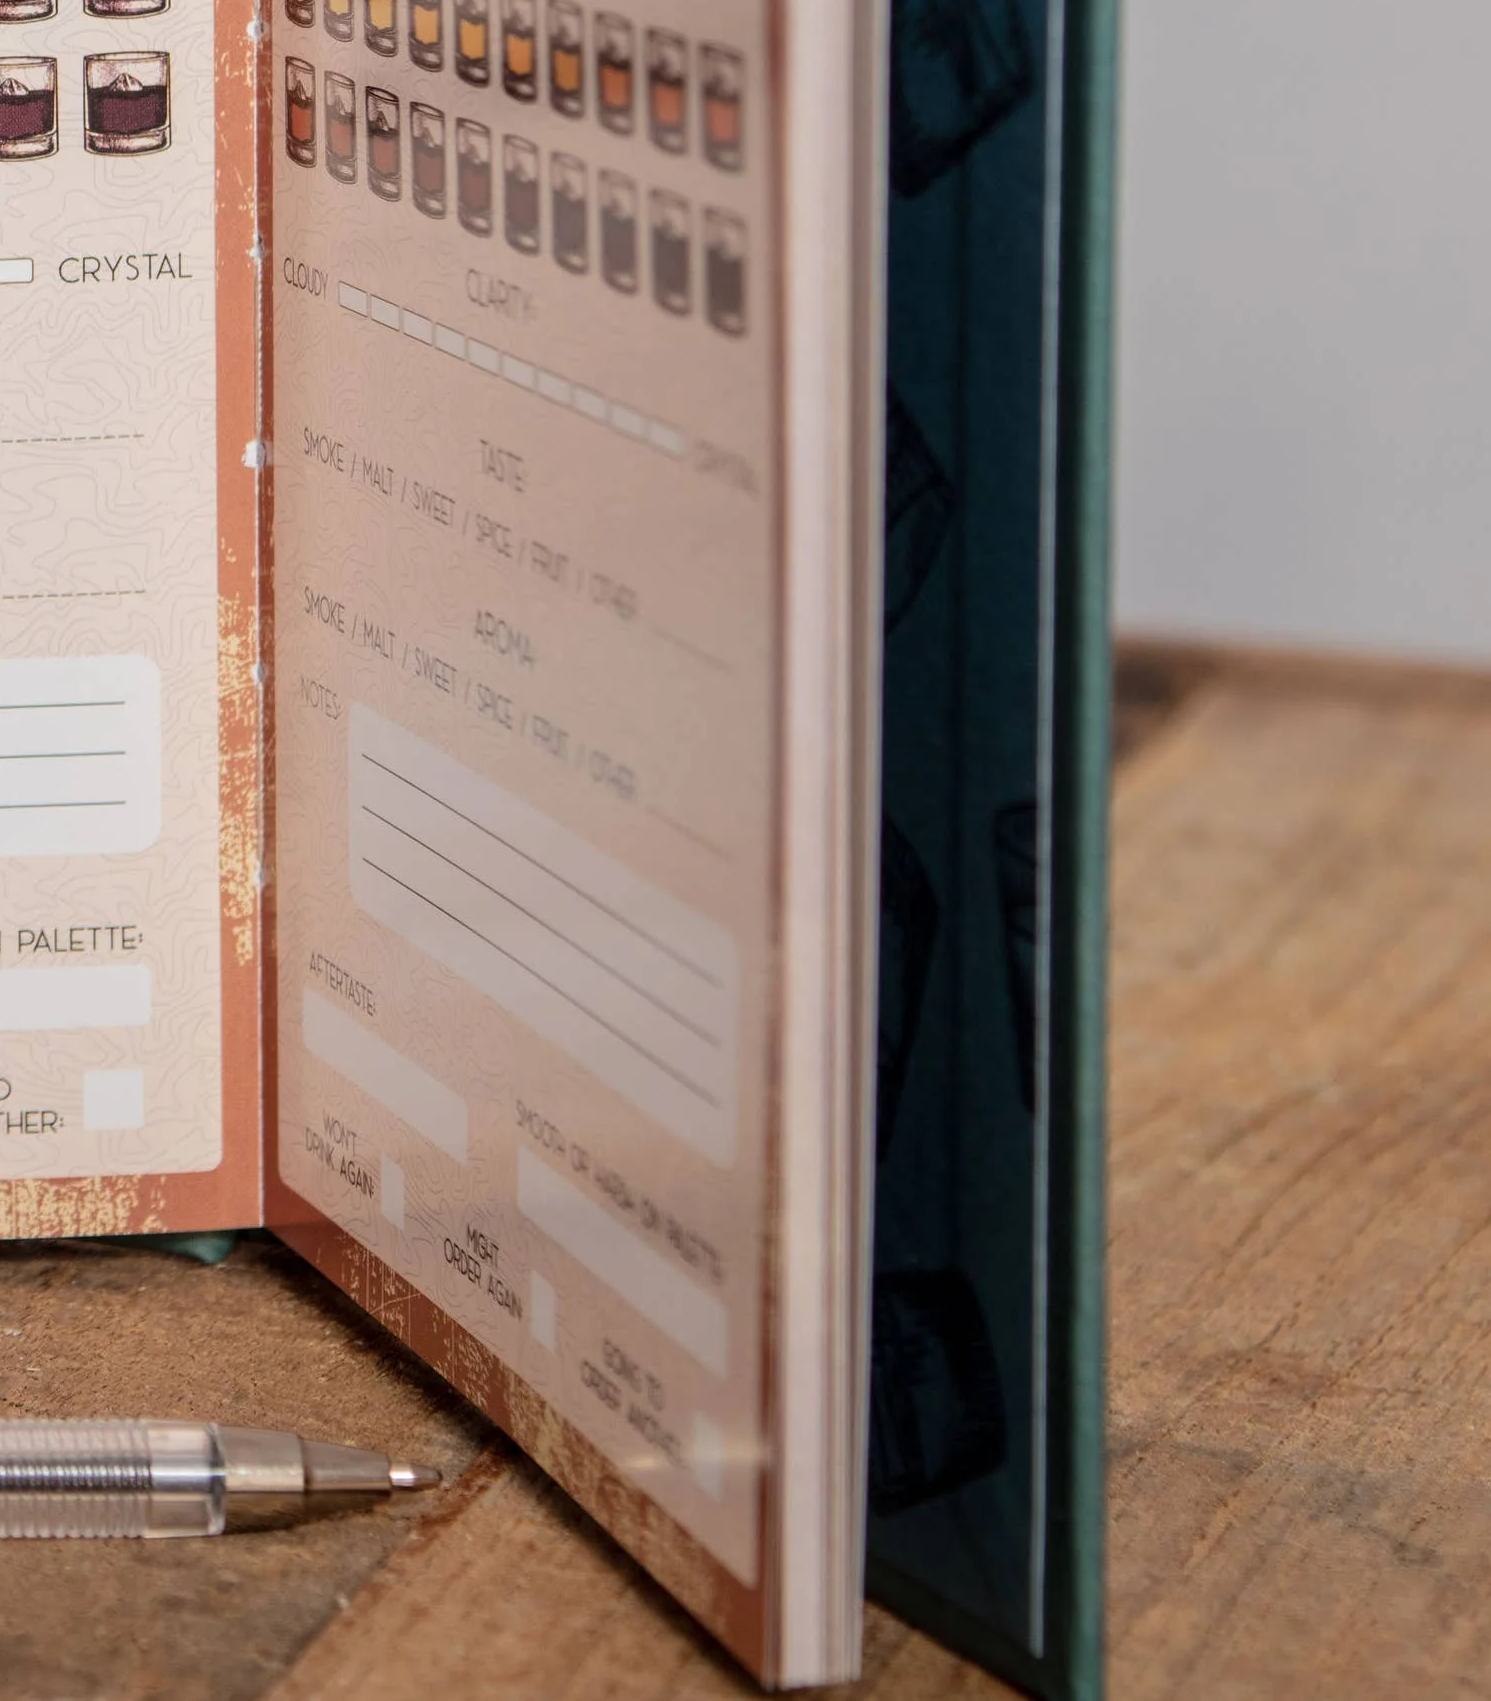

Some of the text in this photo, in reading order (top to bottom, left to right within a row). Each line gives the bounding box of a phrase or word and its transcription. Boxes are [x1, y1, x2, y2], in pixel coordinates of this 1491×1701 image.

[58, 252, 193, 285] CRYSTAL
[283, 257, 329, 300] CLOUDY
[303, 427, 345, 474] SMOKE
[363, 461, 395, 497] MALT
[412, 481, 457, 529] SWEET
[304, 587, 345, 635] SMOKE
[363, 622, 395, 662] MALT
[415, 648, 458, 695] SWEET
[18, 925, 144, 954] PALETTE:
[304, 1129, 336, 1173] DRINK
[443, 1237, 483, 1290] ORDER
